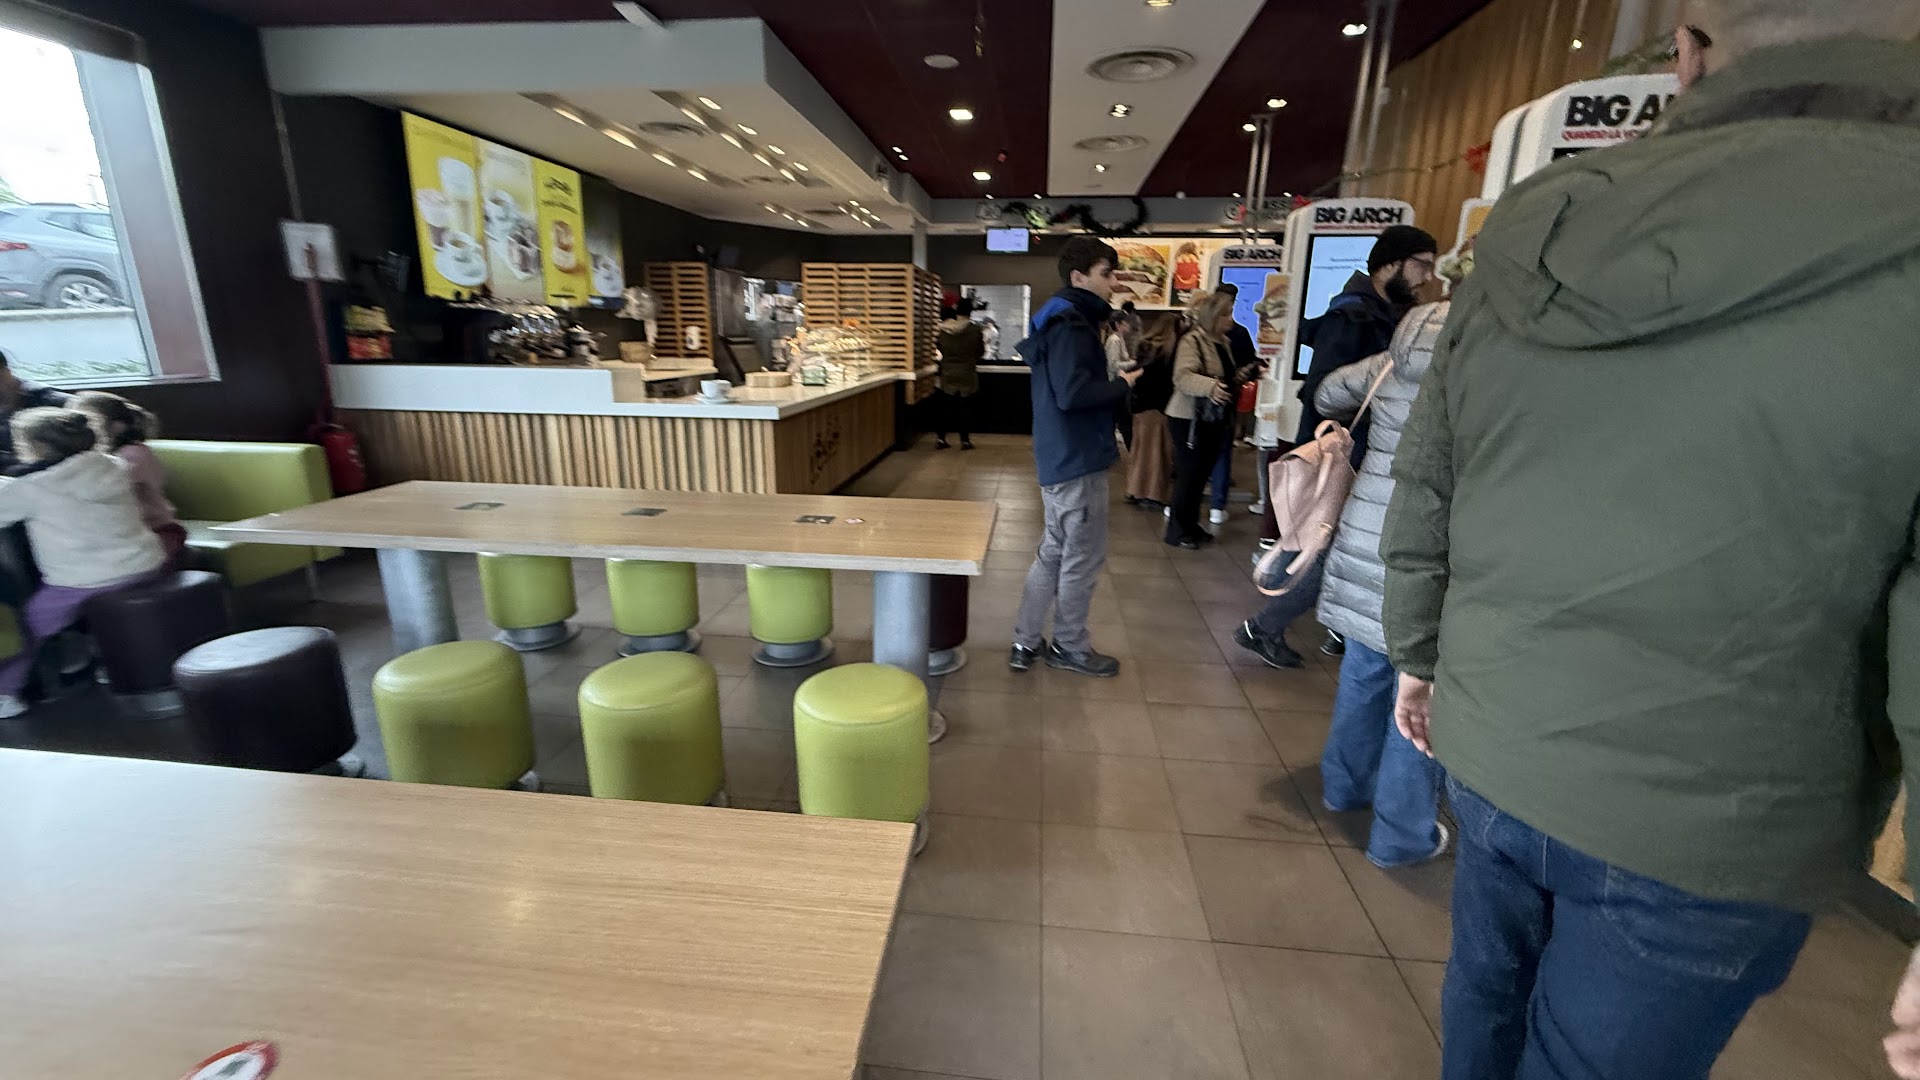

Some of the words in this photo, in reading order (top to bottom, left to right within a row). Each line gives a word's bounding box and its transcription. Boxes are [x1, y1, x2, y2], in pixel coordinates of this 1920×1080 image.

[1565, 94, 1631, 126] BIG
[1314, 207, 1347, 223] BIG
[1349, 207, 1404, 223] ARCH
[1224, 248, 1245, 259] BIG
[1248, 248, 1282, 259] ARCH
